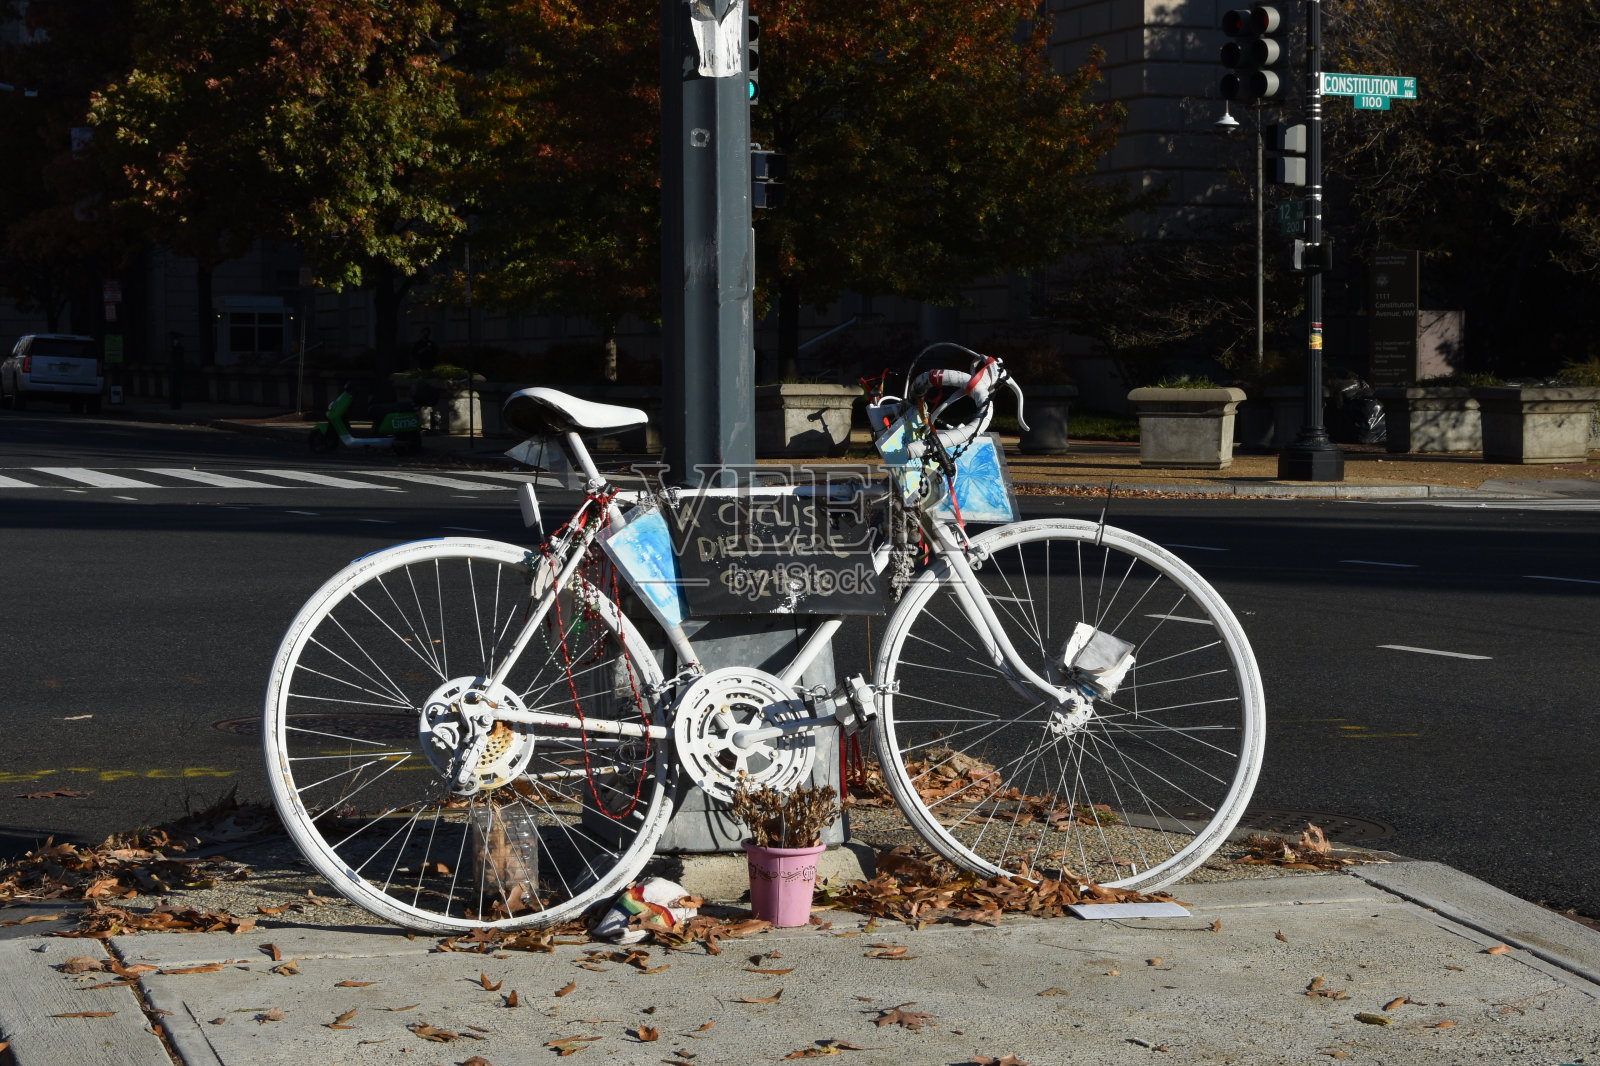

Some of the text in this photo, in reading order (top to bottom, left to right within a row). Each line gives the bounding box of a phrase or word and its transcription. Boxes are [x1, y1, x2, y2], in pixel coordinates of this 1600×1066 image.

[1325, 76, 1415, 95] CONSTITUTION AVE
[1361, 96, 1383, 108] 1100
[1279, 203, 1291, 220] 12
[1286, 222, 1300, 233] 200
[1375, 301, 1415, 309] Constitution
[677, 502, 701, 528] A
[696, 534, 851, 562] DIED HERE
